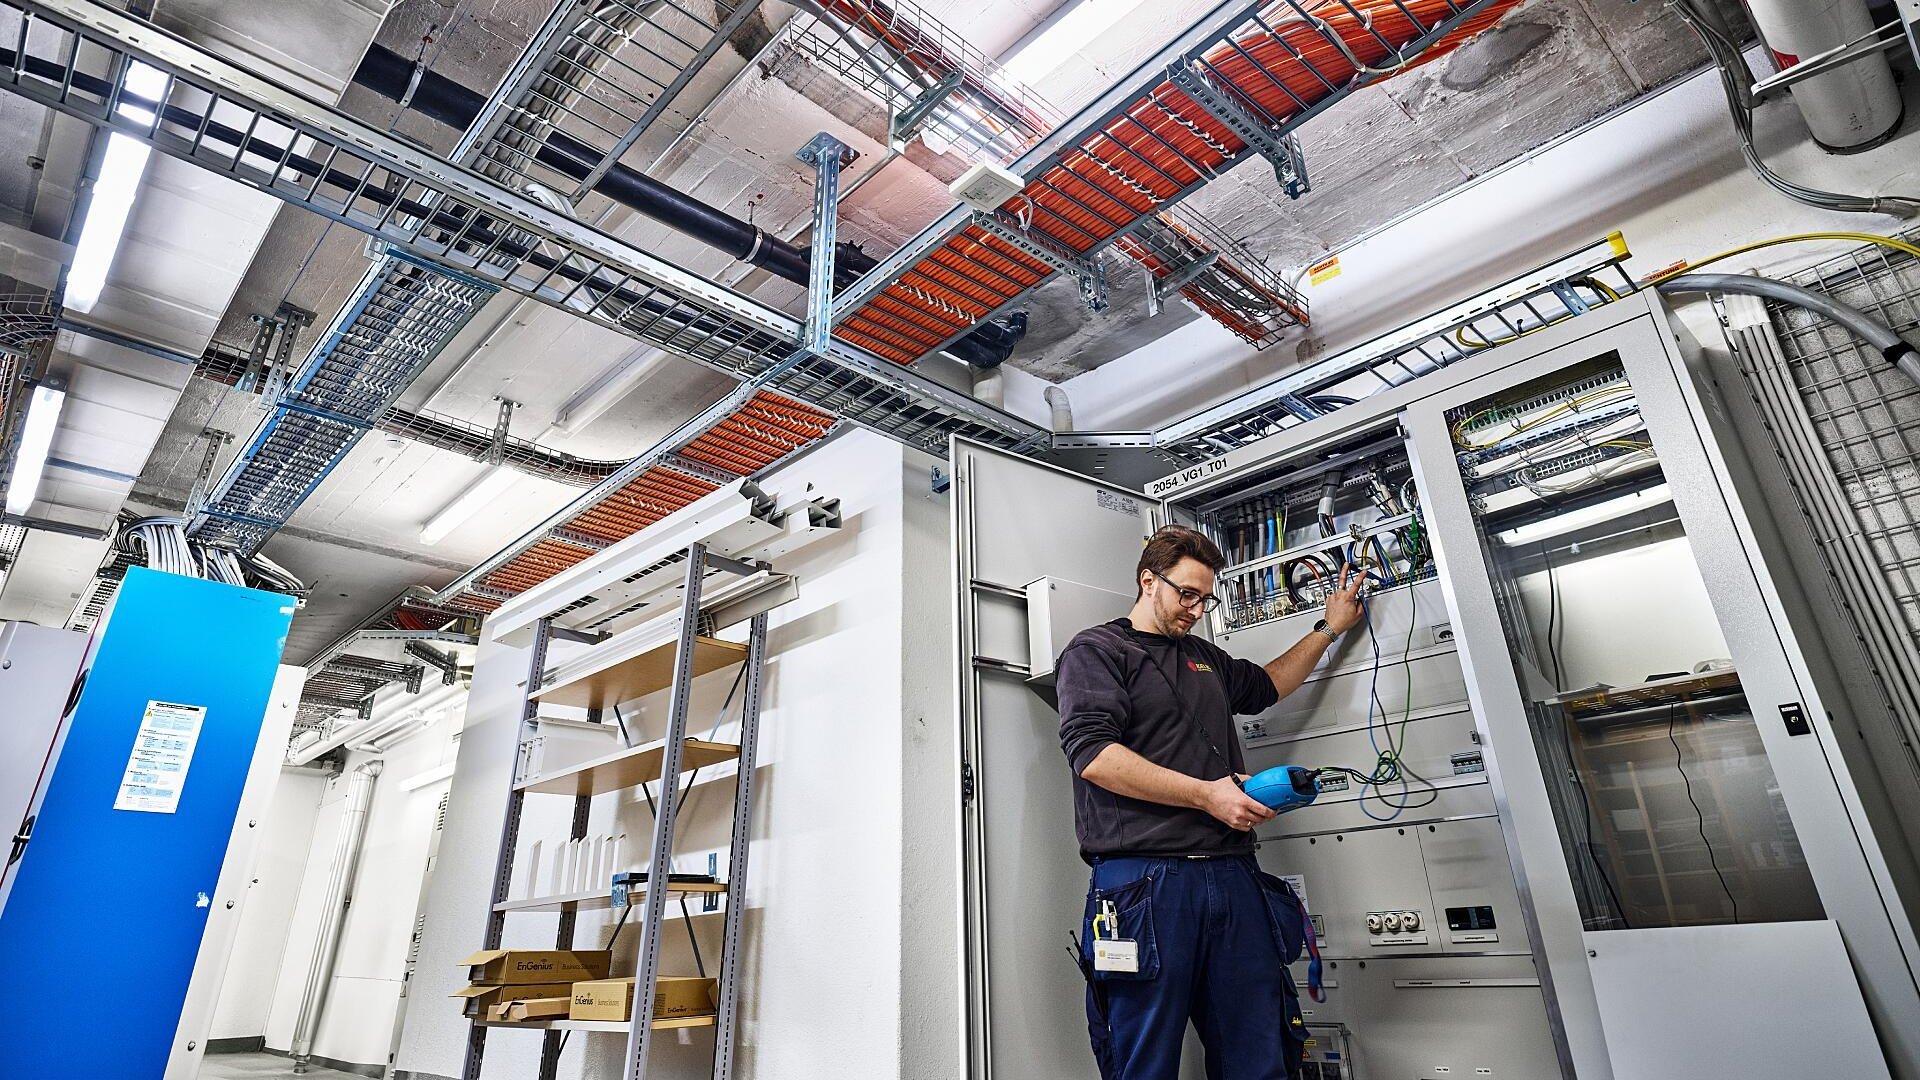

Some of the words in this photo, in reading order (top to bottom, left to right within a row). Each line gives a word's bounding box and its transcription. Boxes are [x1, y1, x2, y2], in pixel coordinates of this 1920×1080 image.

[1153, 457, 1228, 495] 2054_VG1_T01
[517, 960, 553, 971] EnGenius
[575, 994, 594, 1006] EnGenius
